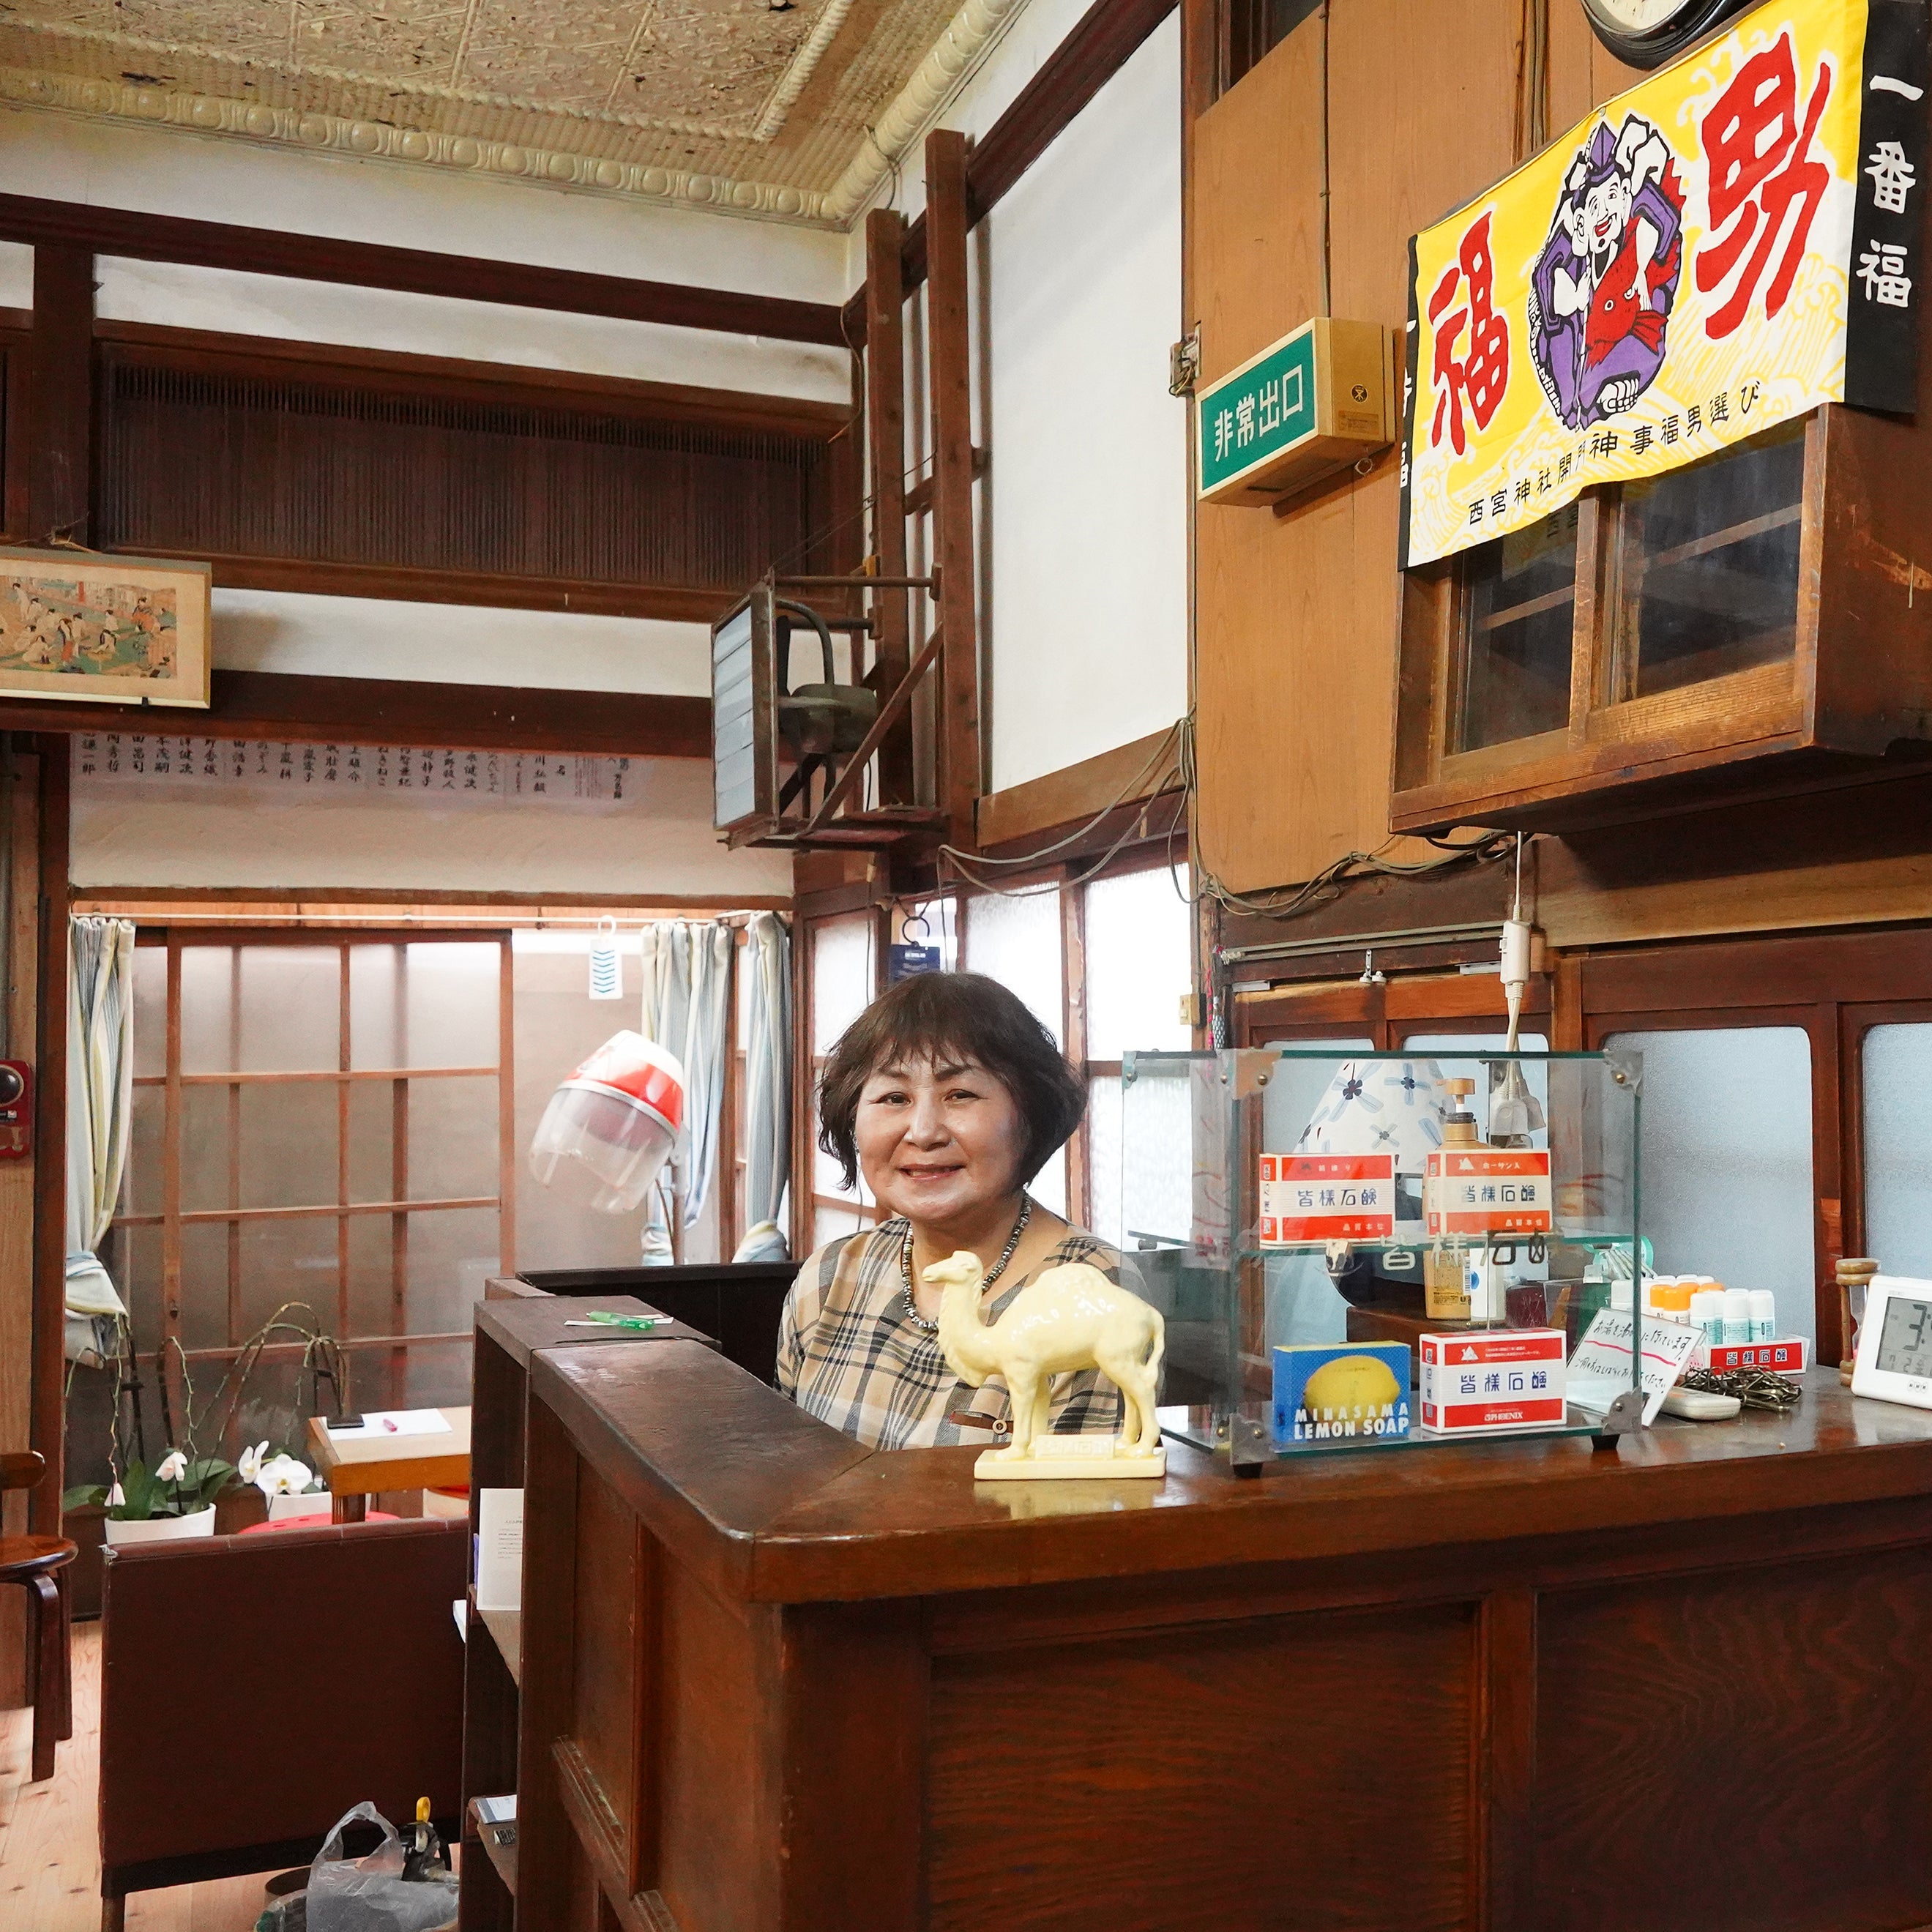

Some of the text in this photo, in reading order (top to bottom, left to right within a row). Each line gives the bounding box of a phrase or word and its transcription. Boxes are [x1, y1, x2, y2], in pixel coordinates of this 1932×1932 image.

[1429, 210, 1509, 455] 福
[1696, 32, 1831, 340] 男
[1855, 75, 1924, 307] 一番福
[1214, 363, 1303, 463] 非常出口
[1469, 380, 1760, 525] 西宮神社開門神事福男選び
[1294, 1417, 1409, 1440] LEMON SOAP
[1295, 1402, 1408, 1422] MINASAMA
